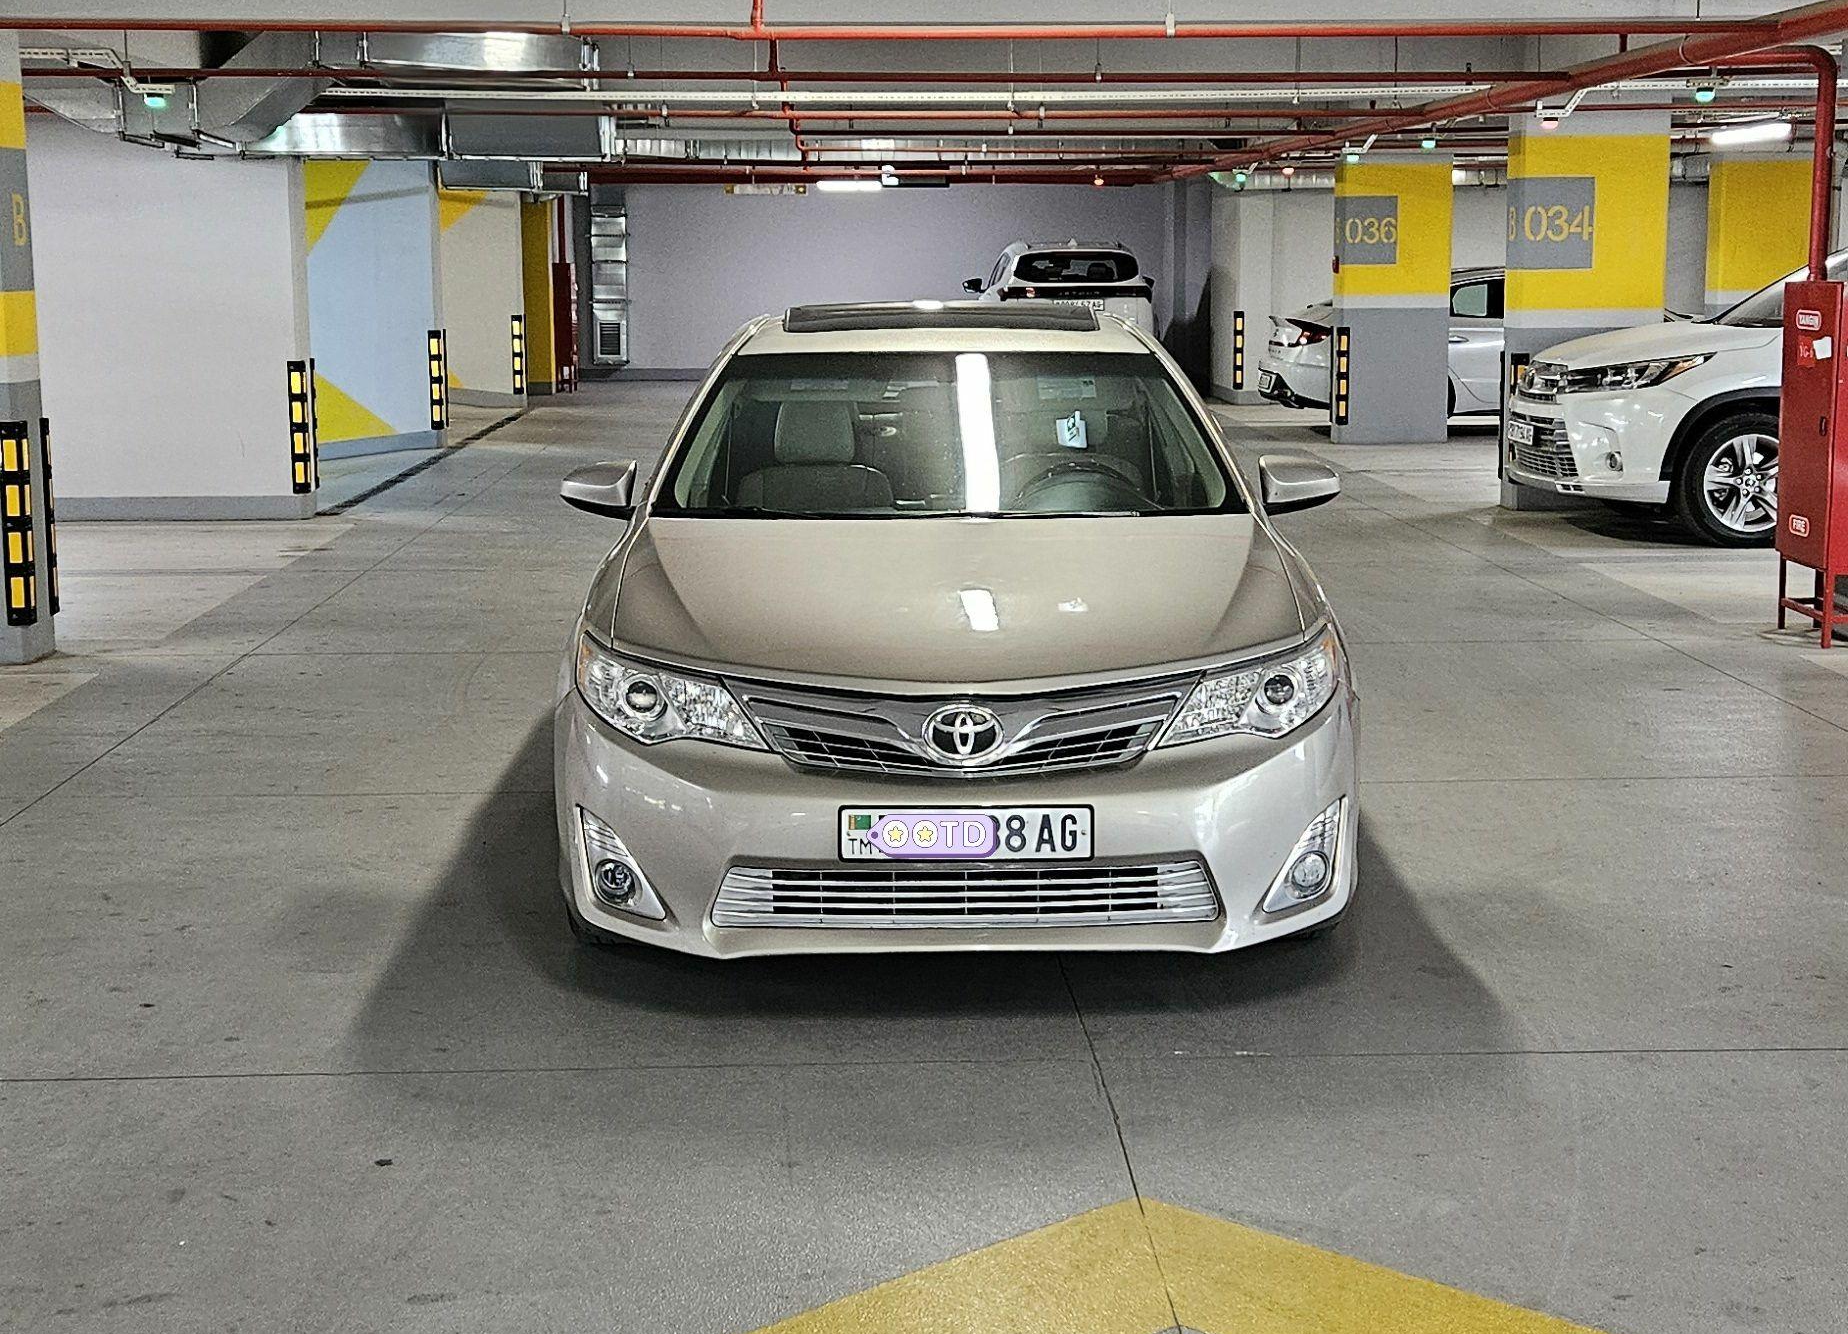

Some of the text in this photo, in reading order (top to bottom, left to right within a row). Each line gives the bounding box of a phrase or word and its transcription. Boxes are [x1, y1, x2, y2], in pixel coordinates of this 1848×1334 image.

[1345, 217, 1398, 244] 036
[1524, 204, 1594, 242] 034
[1035, 814, 1078, 853] AG
